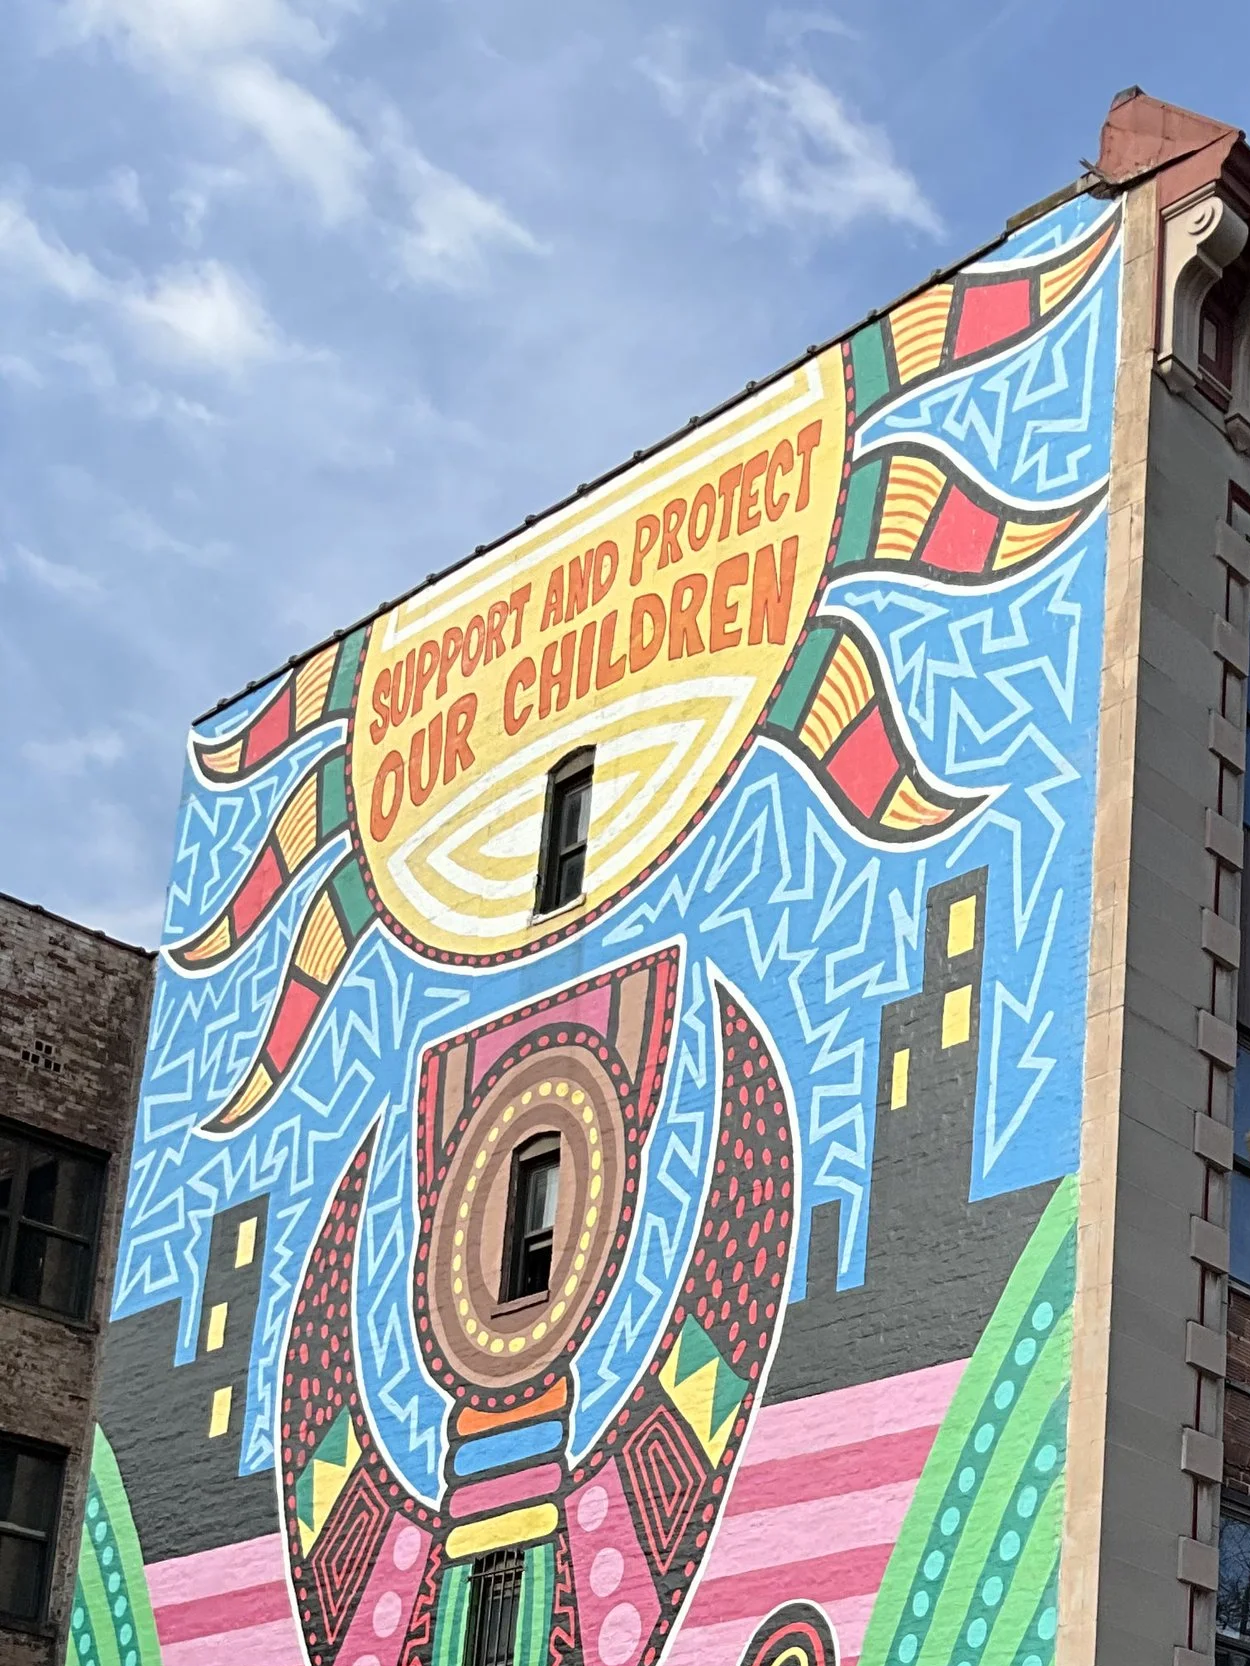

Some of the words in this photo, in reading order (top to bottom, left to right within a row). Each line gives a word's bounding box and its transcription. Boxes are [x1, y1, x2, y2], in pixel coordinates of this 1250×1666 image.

[369, 582, 532, 745] SUPPORT
[540, 540, 620, 632] AND
[629, 419, 823, 587] PROTECT
[369, 692, 478, 843] OUR
[503, 535, 800, 737] CHILDREN
